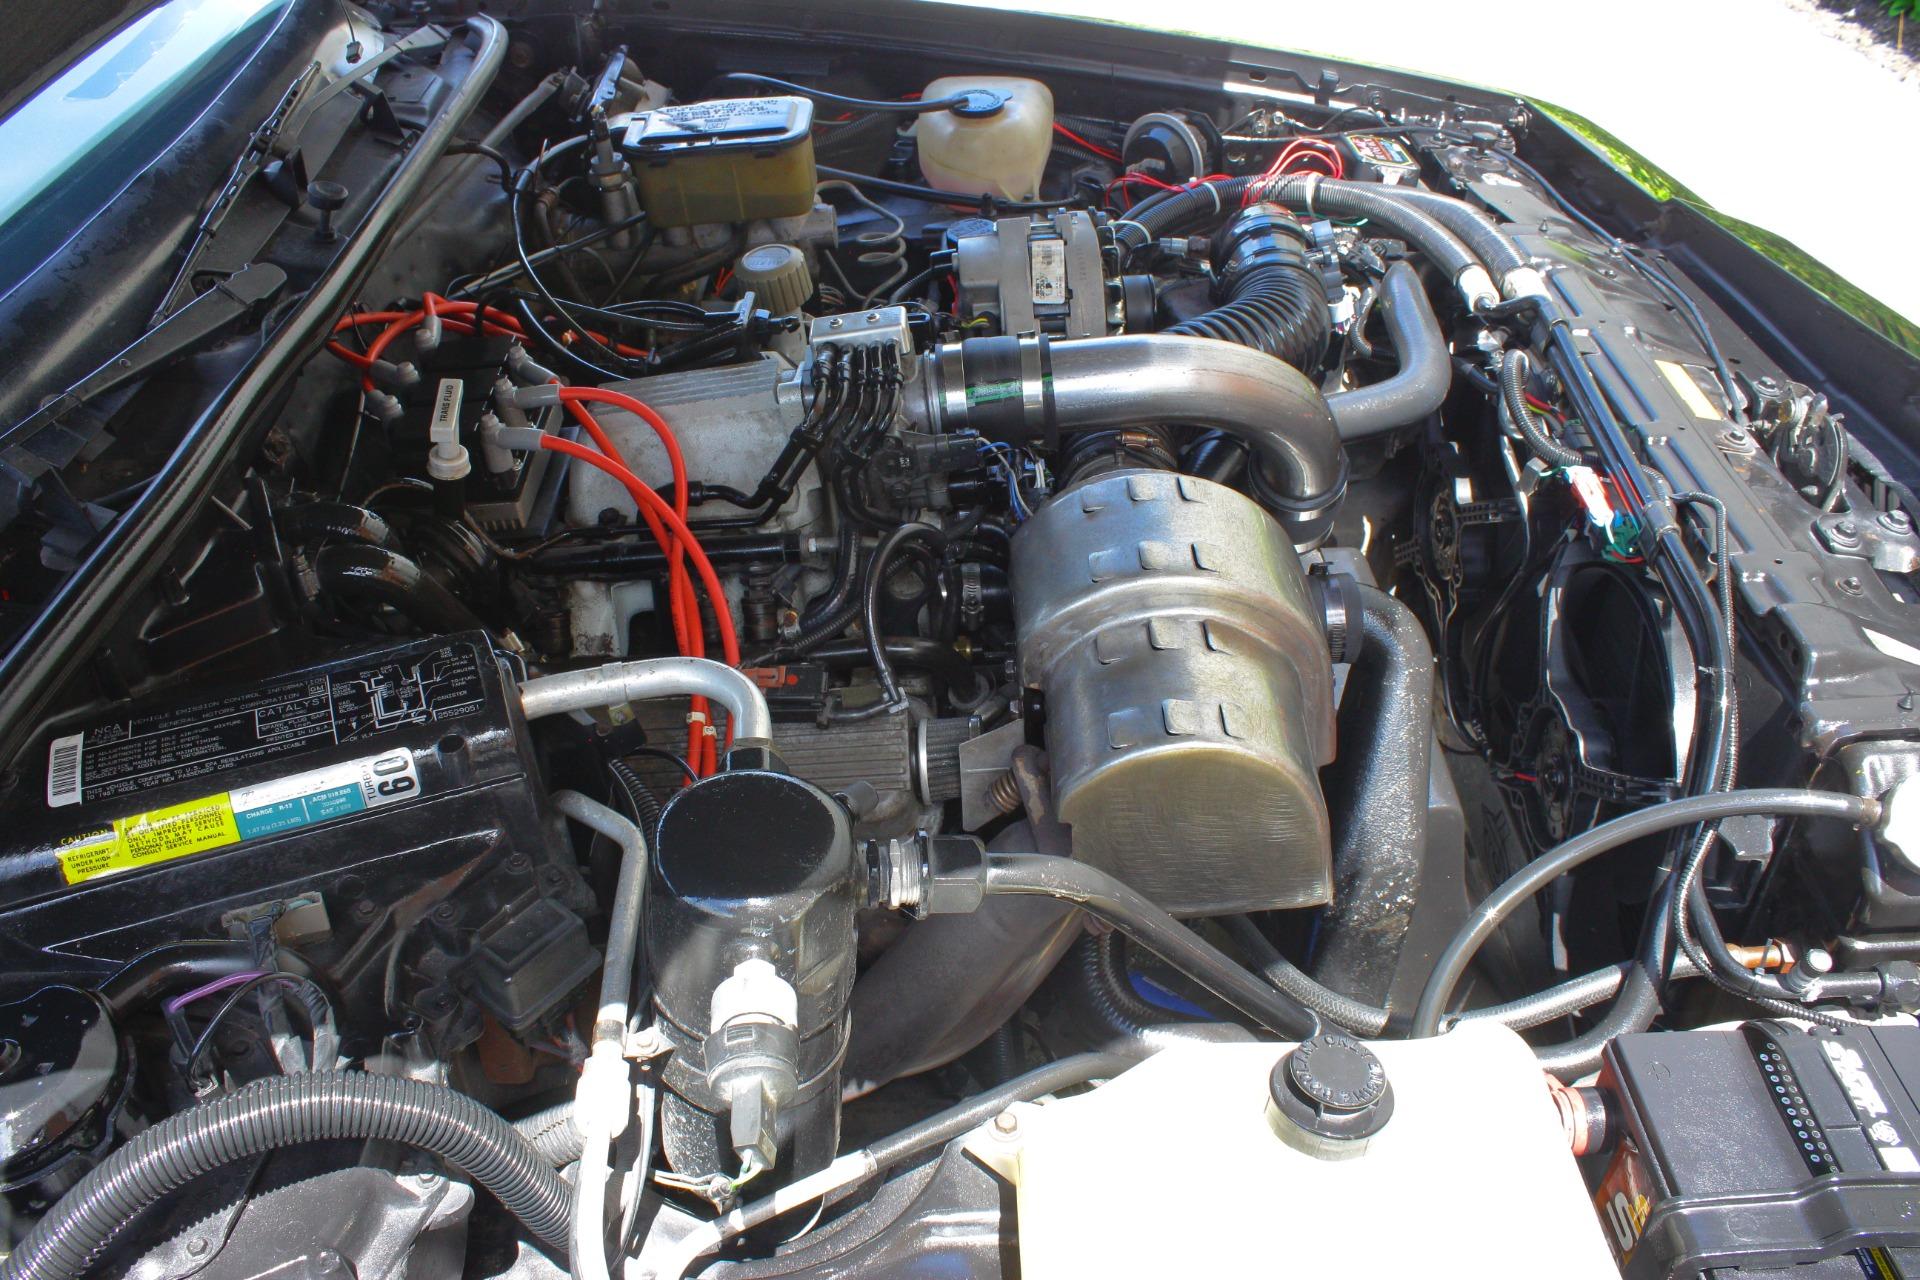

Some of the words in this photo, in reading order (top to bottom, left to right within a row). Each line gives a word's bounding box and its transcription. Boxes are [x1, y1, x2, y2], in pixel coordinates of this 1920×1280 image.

[257, 695, 329, 718] CATALYST
[245, 807, 273, 819] CHARGE
[127, 834, 147, 843] ONLY
[152, 823, 191, 836] IMPROPER
[194, 815, 223, 826] SERVICE
[138, 820, 178, 835] QUALIFIED
[180, 810, 222, 824] PERSONNEL
[60, 828, 109, 845] CAUTION
[128, 834, 170, 848] METHODS
[174, 828, 192, 837] MAY
[197, 820, 224, 831] CAUSE
[130, 841, 162, 853] PERSONAL
[131, 846, 162, 858] CONSULT
[165, 839, 193, 850] SERVICE
[196, 831, 225, 842] MANUAL
[67, 847, 110, 862] REFRIGERANT
[71, 858, 94, 868] UNDER
[94, 854, 111, 863] HIGH
[76, 861, 110, 874] PRESSURE
